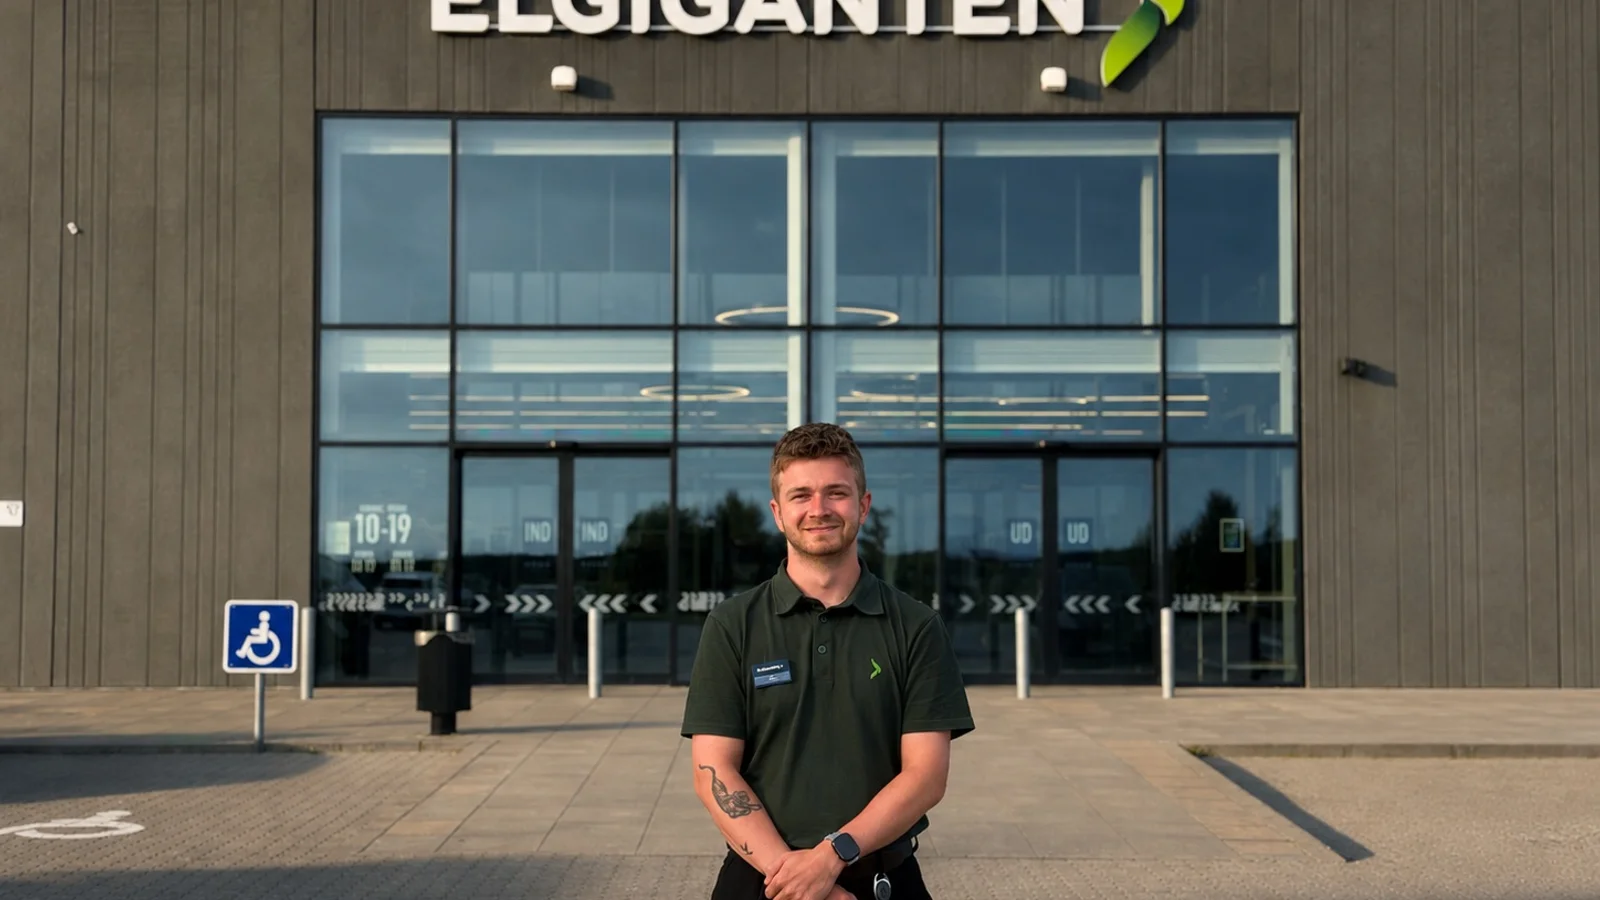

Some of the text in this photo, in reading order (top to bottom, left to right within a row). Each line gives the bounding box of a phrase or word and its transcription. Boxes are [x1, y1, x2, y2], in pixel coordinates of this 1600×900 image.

[355, 513, 412, 545] 10-19
[524, 521, 552, 543] IND
[581, 521, 609, 543] IND
[1010, 521, 1033, 544] UD
[1067, 521, 1090, 544] UD
